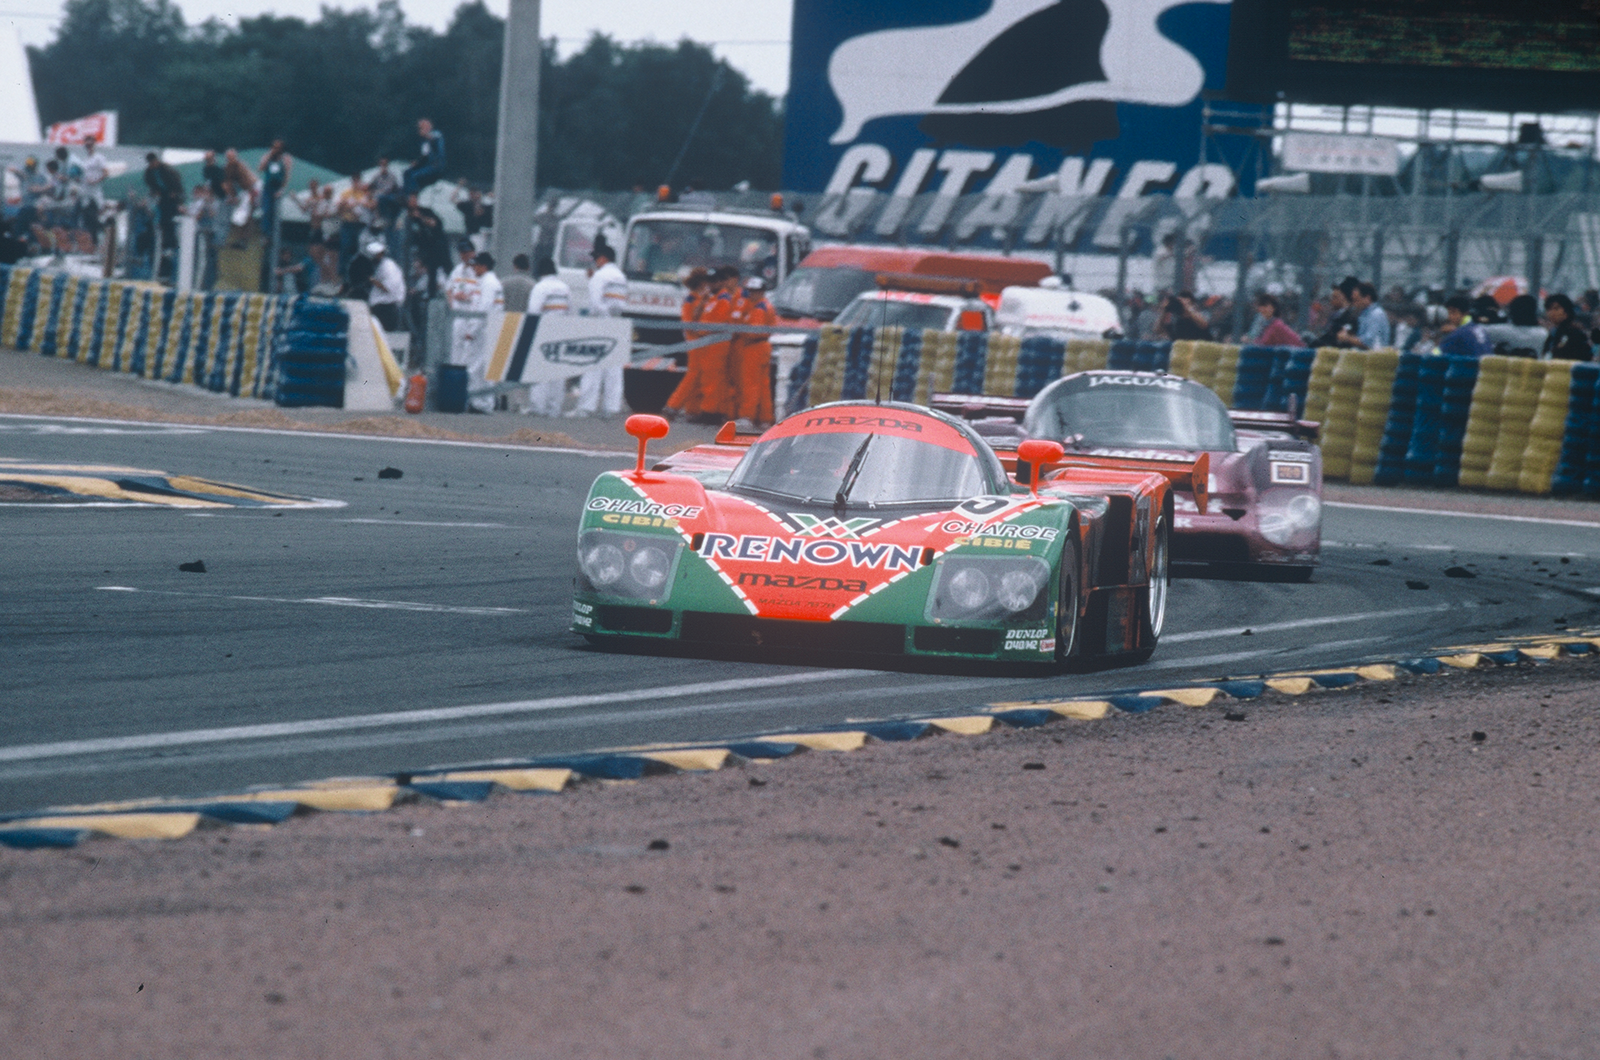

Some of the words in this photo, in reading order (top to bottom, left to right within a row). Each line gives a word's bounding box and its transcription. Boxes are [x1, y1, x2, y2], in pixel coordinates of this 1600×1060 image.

[1089, 376, 1182, 390] JAGUAR
[587, 496, 703, 519] CHARGE
[942, 519, 1059, 542] CHARGE
[699, 533, 924, 572] RENOWN
[1005, 629, 1049, 640] DUNLOP
